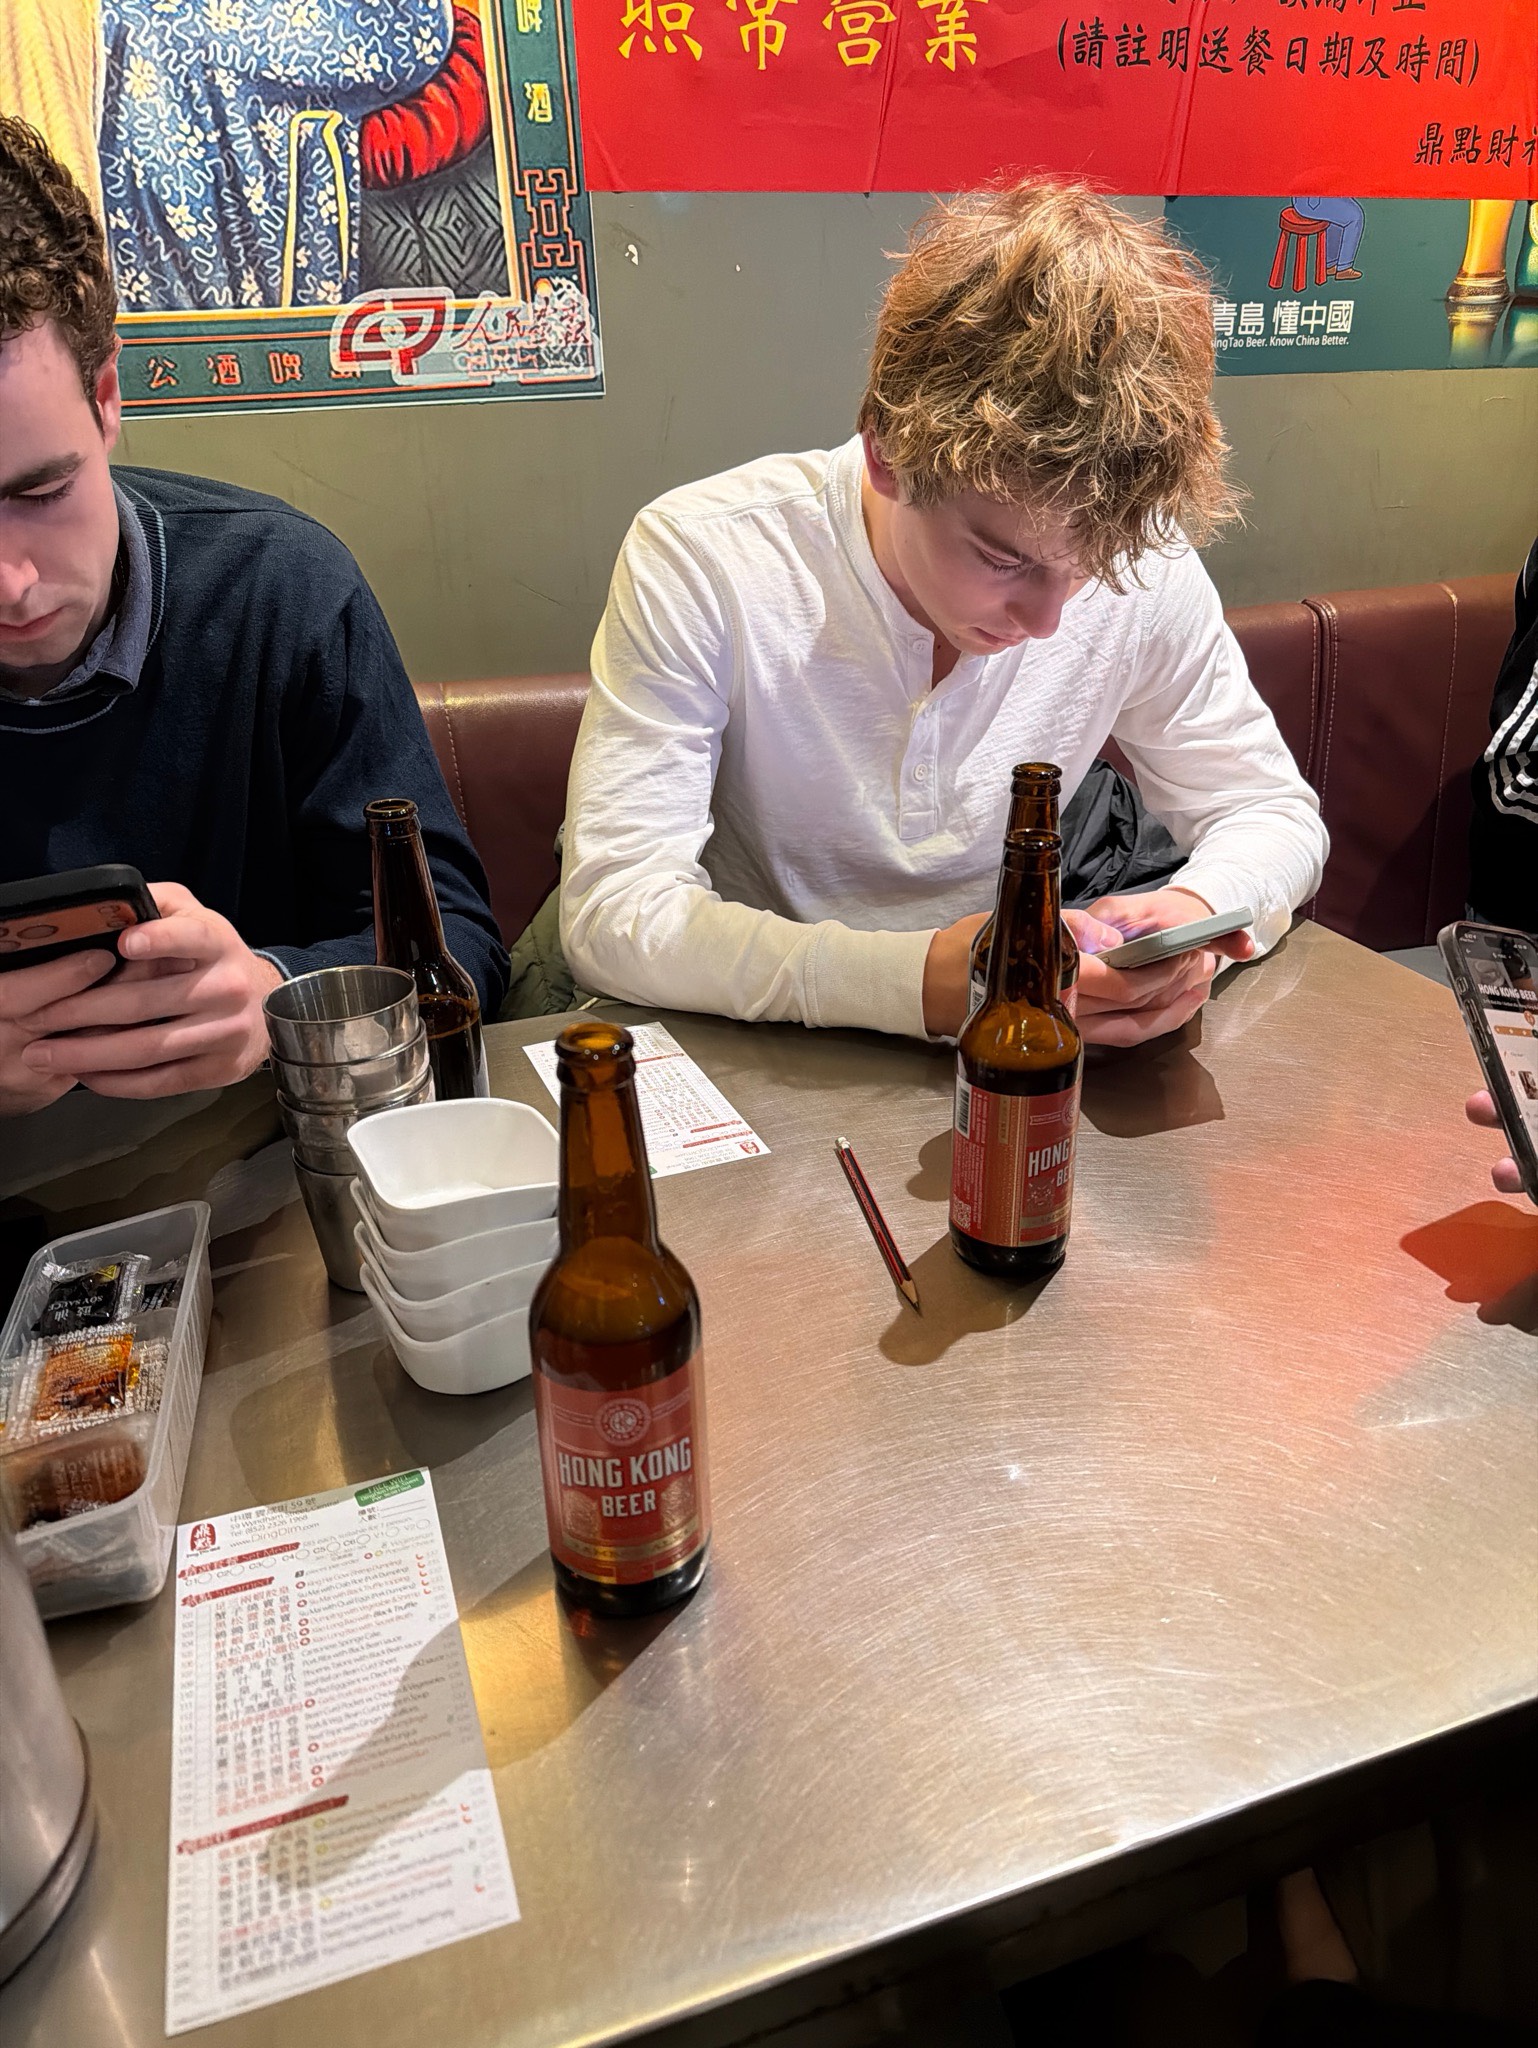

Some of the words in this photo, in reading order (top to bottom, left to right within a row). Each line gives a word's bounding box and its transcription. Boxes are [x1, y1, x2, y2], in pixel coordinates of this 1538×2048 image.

[1056, 16, 1480, 88] (請註明送餐日期及時間)
[1272, 300, 1354, 335] 懂中國
[1246, 336, 1268, 348] Beer.
[1269, 335, 1294, 347] Know
[1295, 334, 1320, 346] China
[1321, 334, 1349, 346] Better.
[1478, 983, 1500, 995] HONG
[1500, 985, 1520, 998] KONG
[1520, 989, 1538, 1001] BEER
[1028, 1137, 1070, 1178] HONG
[558, 1451, 623, 1488] HONG
[630, 1437, 692, 1486] KONG
[601, 1489, 657, 1518] BEER
